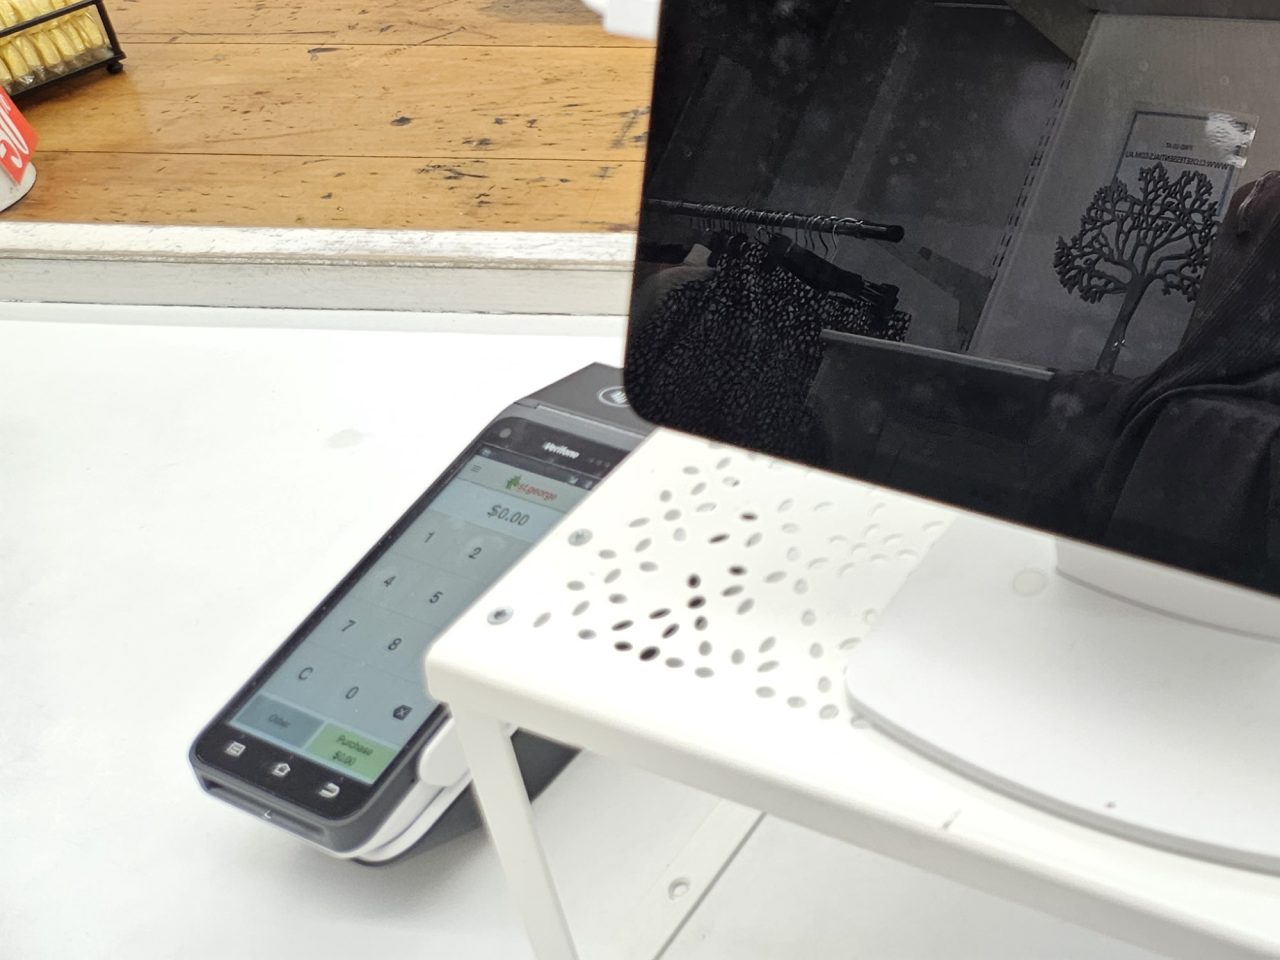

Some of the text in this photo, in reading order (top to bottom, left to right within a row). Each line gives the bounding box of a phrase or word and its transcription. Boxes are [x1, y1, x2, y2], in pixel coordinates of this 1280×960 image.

[486, 503, 530, 527] $0.00
[423, 531, 436, 544] 1
[467, 546, 482, 561] 2
[383, 575, 397, 588] 4
[428, 590, 444, 604] 5
[341, 619, 357, 632] 7
[388, 637, 403, 652] 8
[298, 666, 314, 681] C
[344, 685, 360, 701] 0
[335, 734, 374, 756] Purchase
